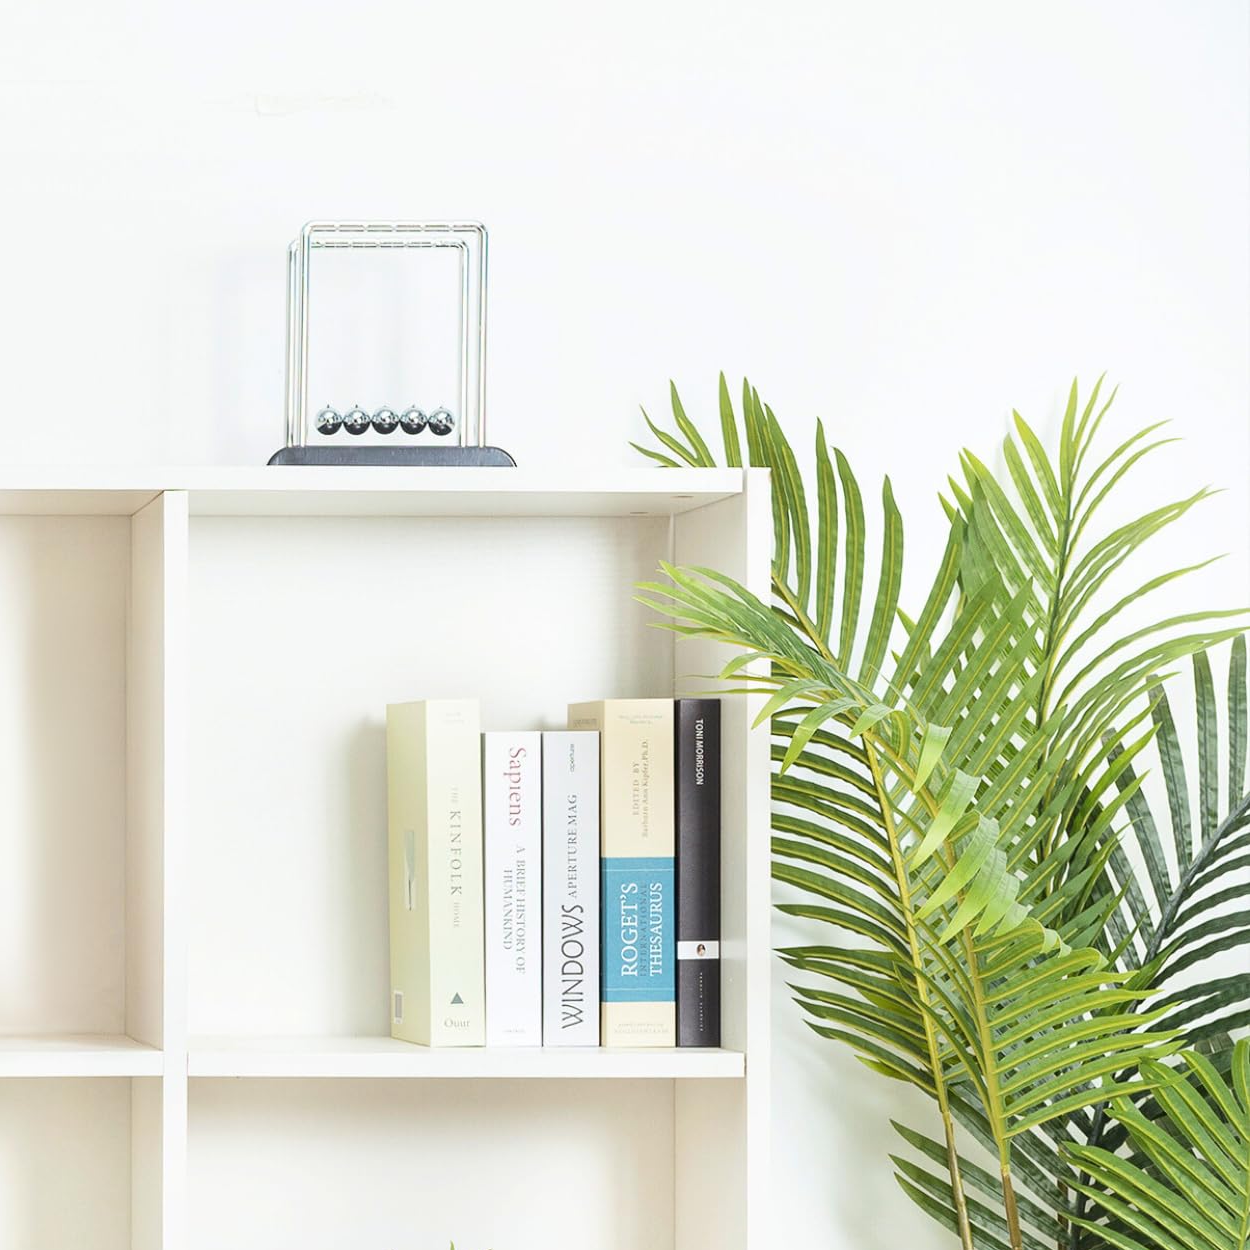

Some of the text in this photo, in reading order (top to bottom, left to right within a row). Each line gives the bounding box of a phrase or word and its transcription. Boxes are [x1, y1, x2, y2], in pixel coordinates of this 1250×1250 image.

[503, 747, 527, 827] Sapiens
[632, 761, 640, 816] EDITED BY
[695, 719, 704, 785] TONI MORRISON
[449, 809, 462, 896] KINFOLK
[516, 860, 526, 897] BRIEF
[502, 869, 513, 950] HUMANKIND
[516, 898, 526, 954] HISTORY
[561, 794, 584, 1029] WINDOWS APERTURE MAG
[620, 882, 639, 977] ROGET'S
[649, 882, 663, 977] THESAURUS
[515, 956, 526, 974] OF
